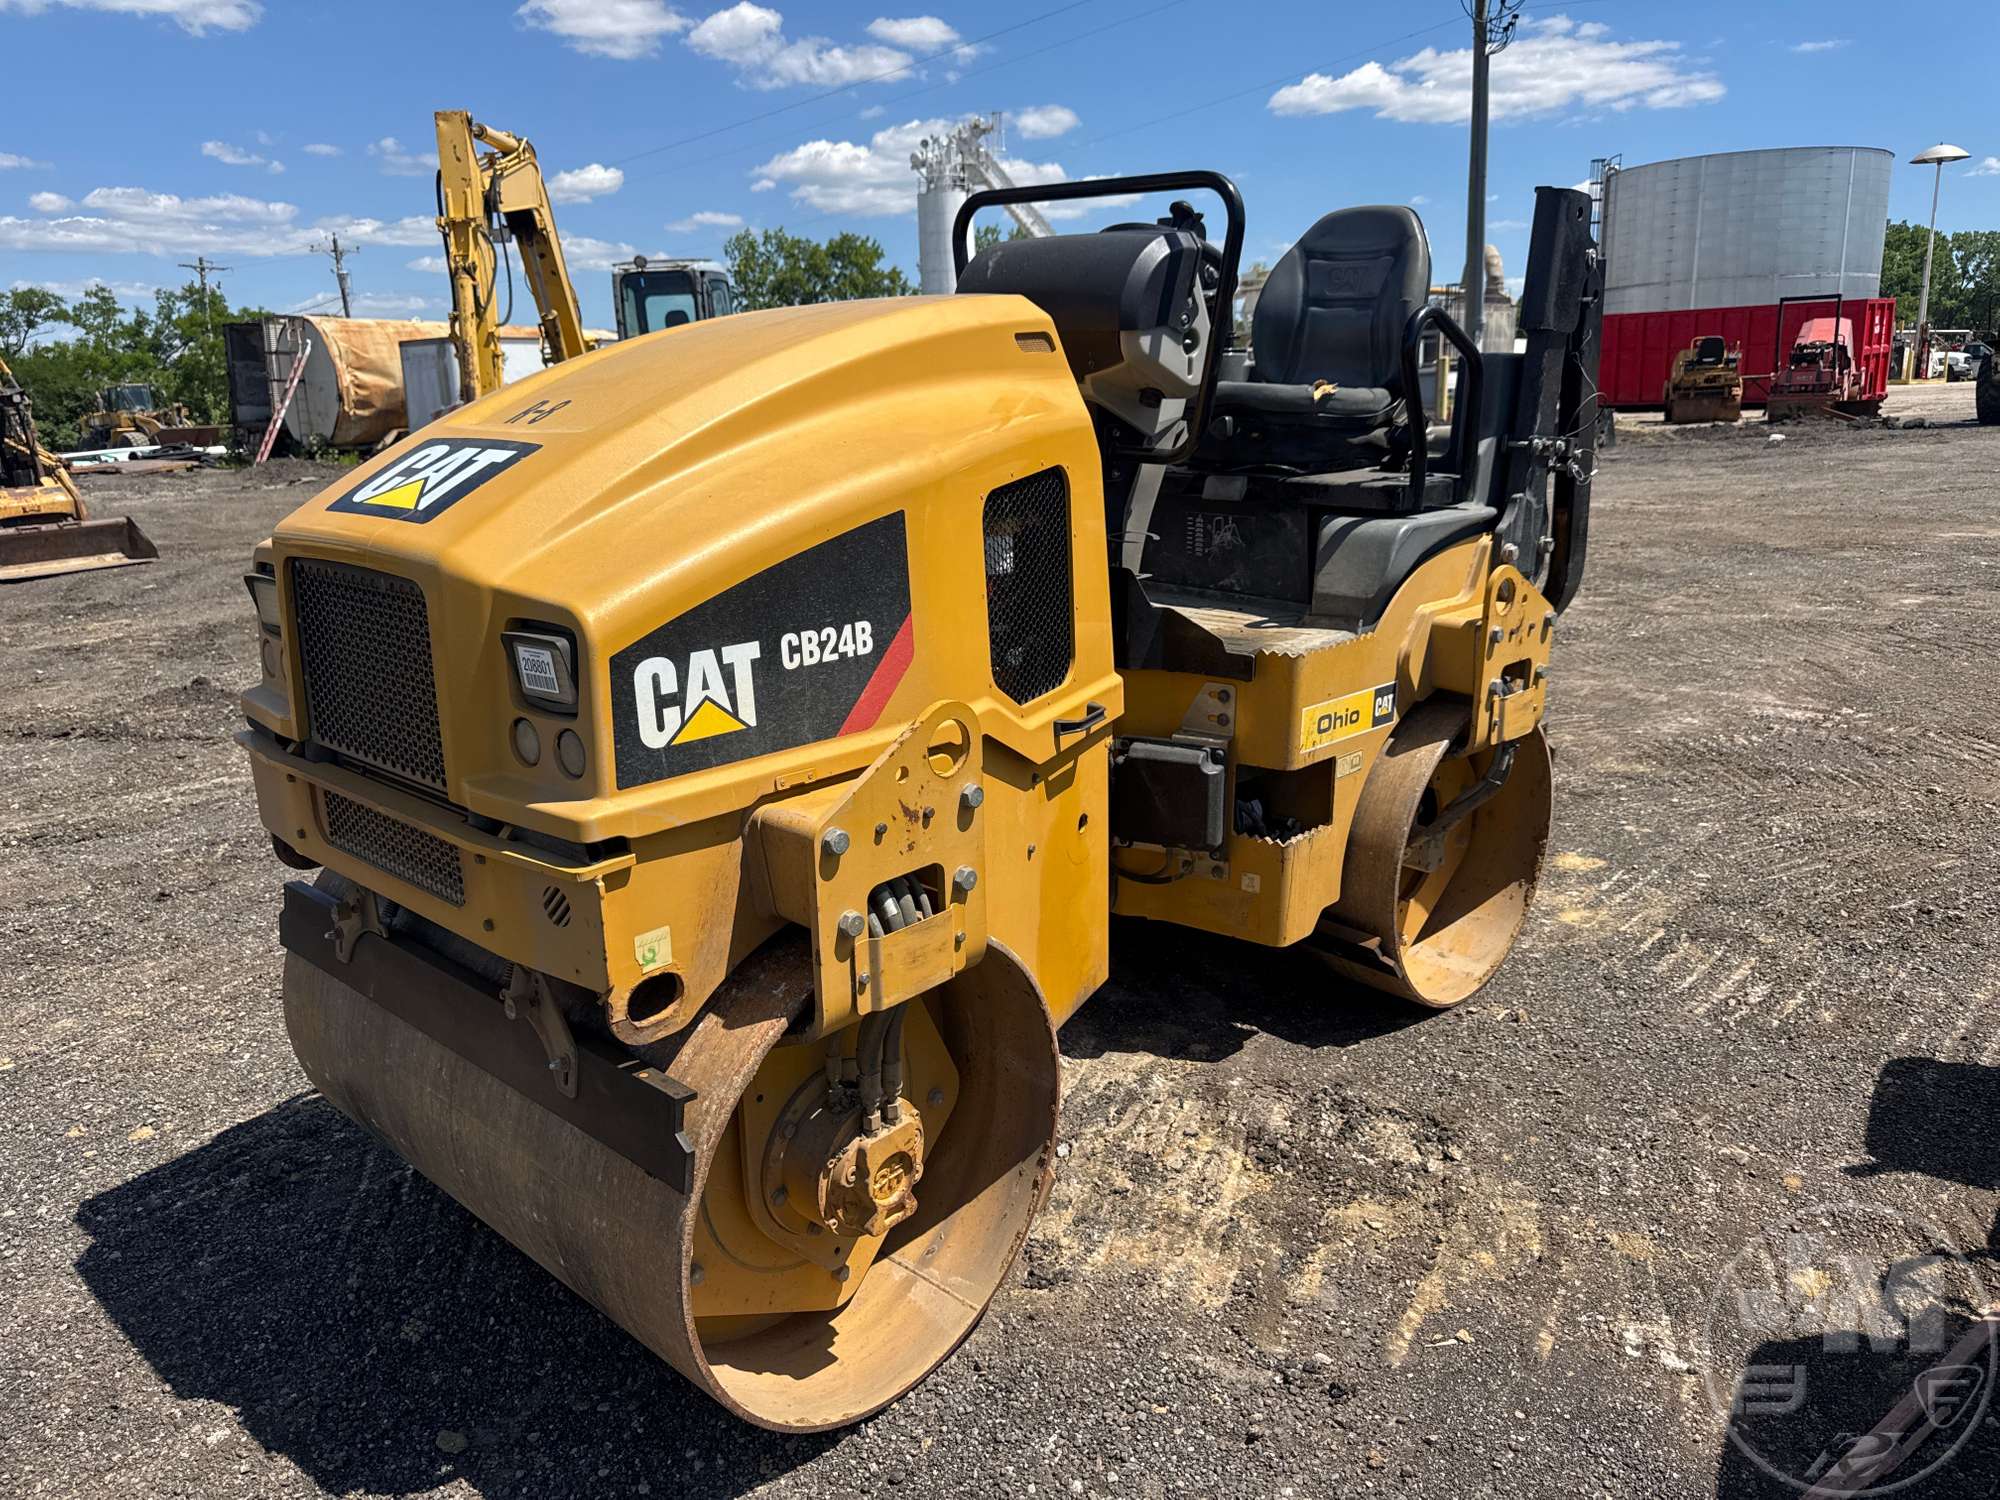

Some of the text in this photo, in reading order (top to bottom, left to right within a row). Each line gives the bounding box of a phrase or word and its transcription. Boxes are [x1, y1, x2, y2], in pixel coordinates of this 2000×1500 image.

[352, 444, 519, 511] CAT
[521, 656, 552, 676] 208801
[780, 620, 874, 670] CB24B
[633, 640, 761, 749] CAT
[1317, 693, 1395, 735] Ohio CAT
